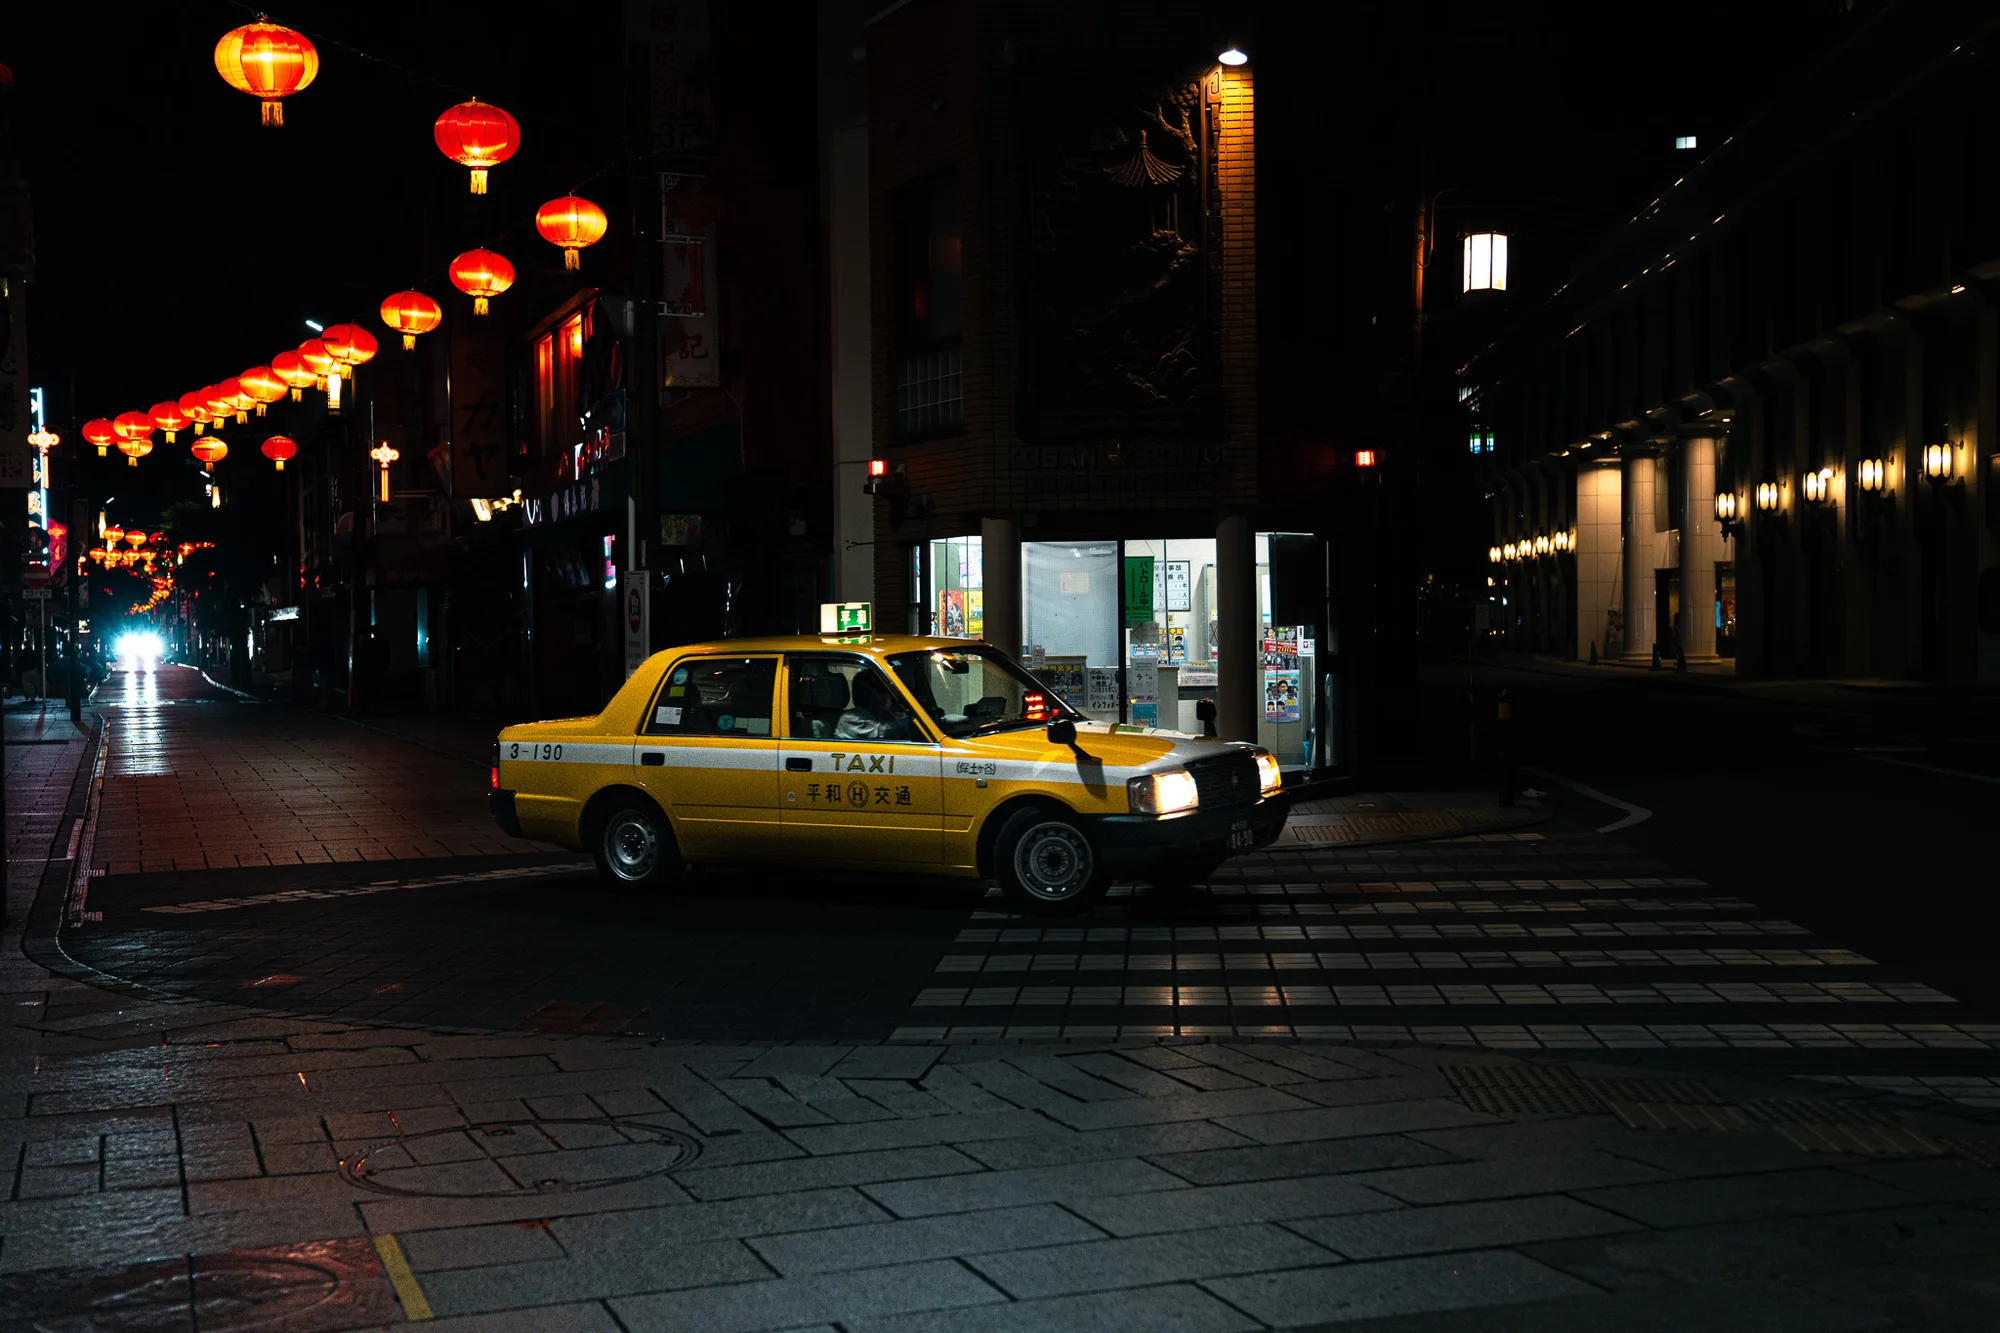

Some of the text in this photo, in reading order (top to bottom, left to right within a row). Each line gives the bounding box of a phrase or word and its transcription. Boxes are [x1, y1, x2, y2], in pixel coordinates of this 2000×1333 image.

[831, 753, 895, 774] TAXI
[806, 784, 842, 803] 平和
[874, 786, 912, 806] 交通
